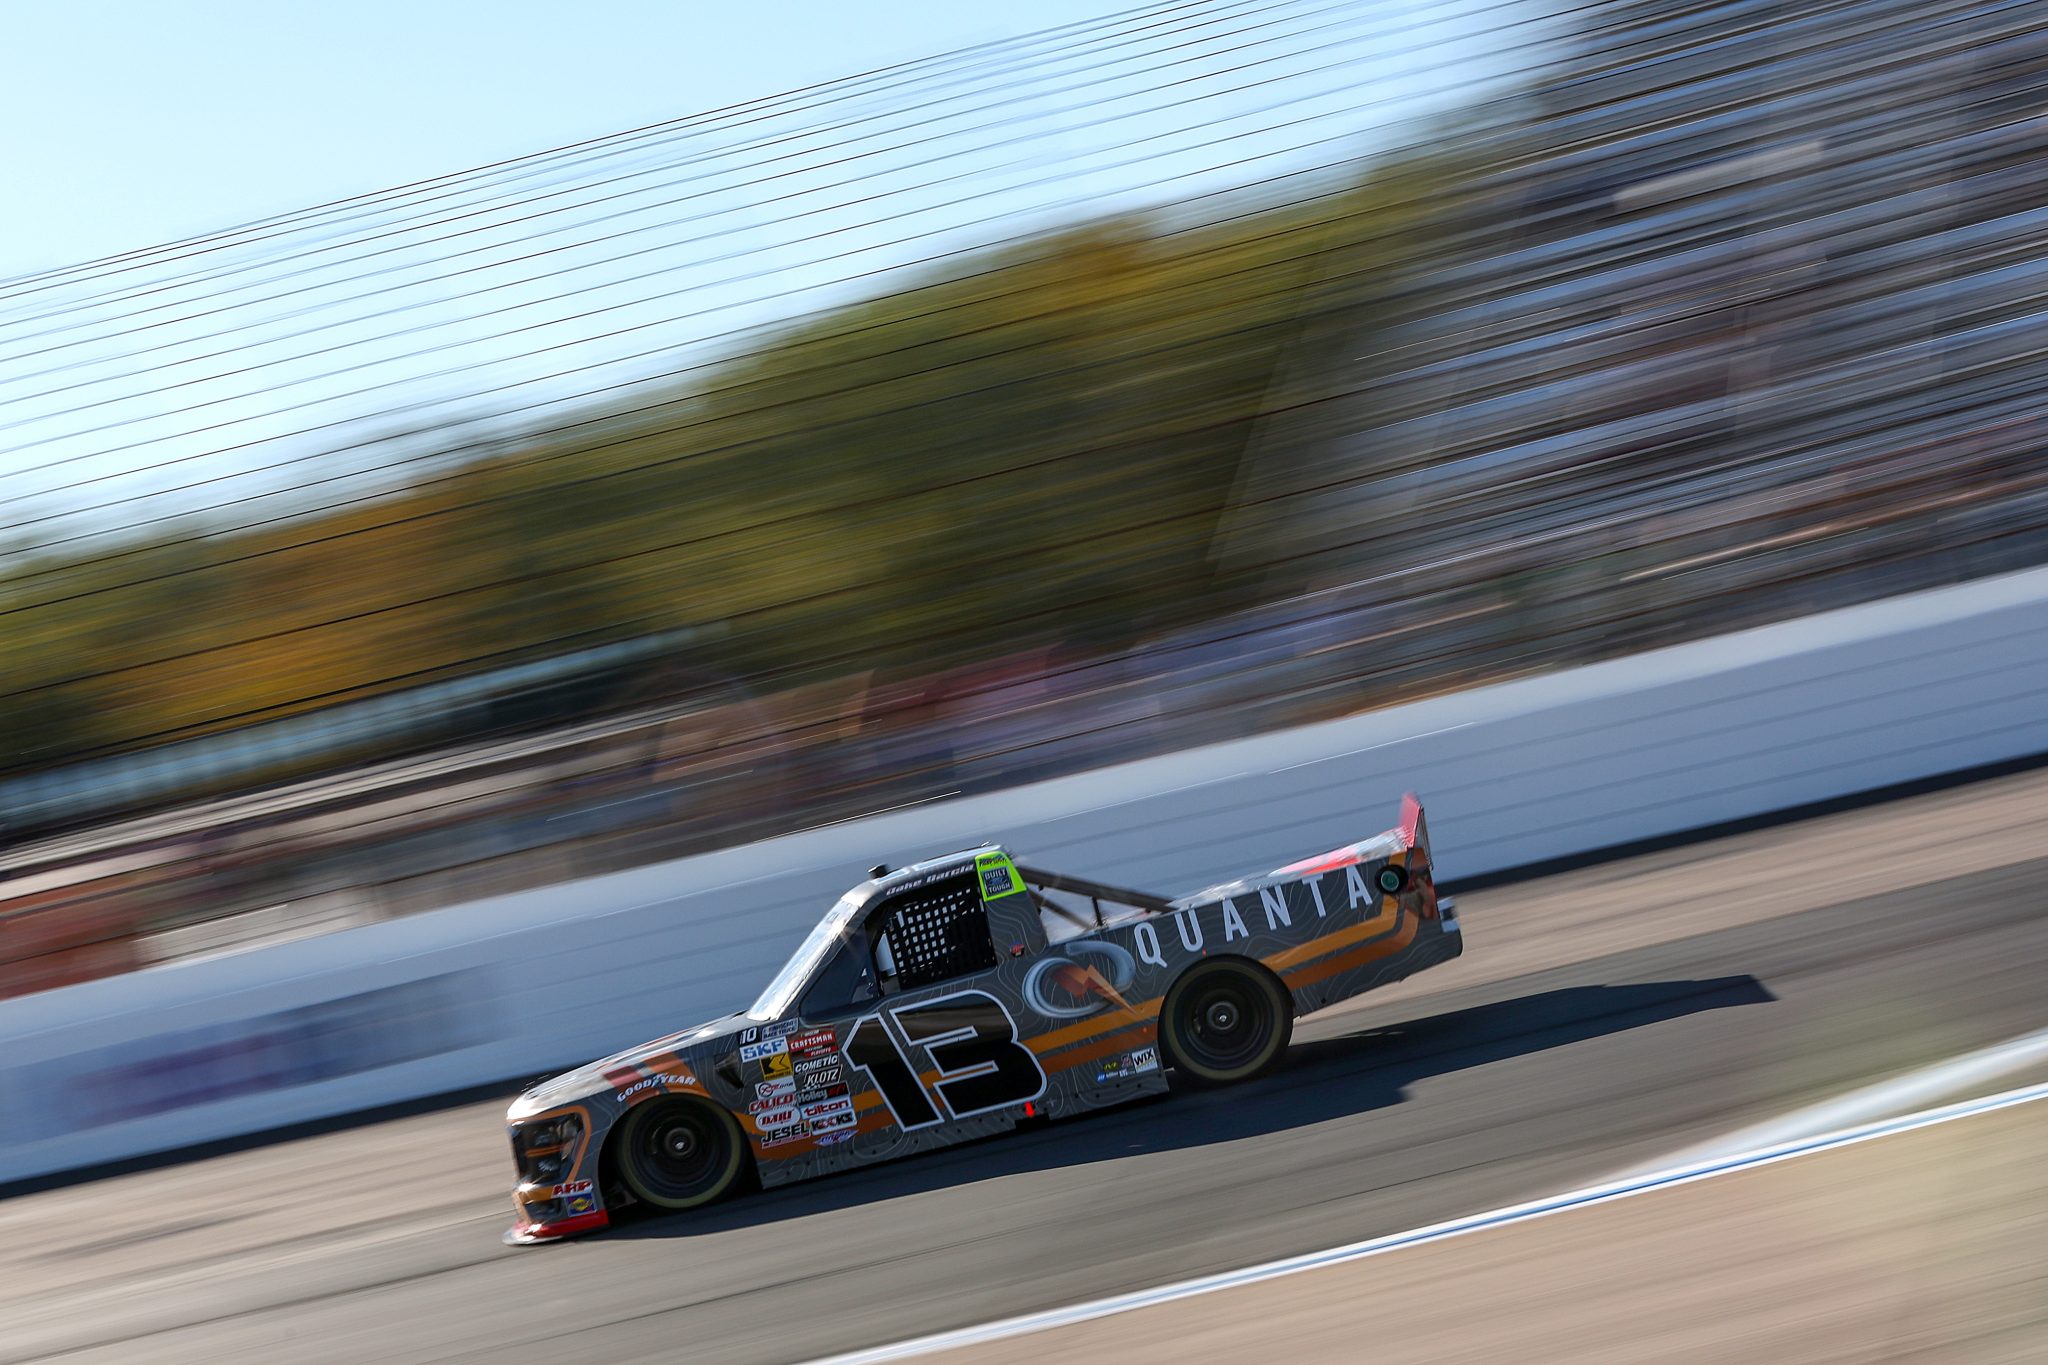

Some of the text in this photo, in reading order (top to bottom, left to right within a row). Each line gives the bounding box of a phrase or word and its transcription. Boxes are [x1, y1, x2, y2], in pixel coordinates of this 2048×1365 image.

[985, 868, 1006, 879] BUILT
[988, 883, 1011, 894] TOUGH
[1134, 865, 1373, 969] QUANTA
[740, 1027, 758, 1045] 10
[790, 1033, 833, 1050] CRAFTSMAN
[743, 1039, 785, 1060] SKF
[1134, 1049, 1154, 1066] WIX
[794, 1055, 838, 1073] COMETIC
[841, 988, 1048, 1132] 13
[806, 1068, 839, 1086] KLOTZ
[616, 1073, 697, 1103] GOODYEAR
[797, 1089, 828, 1104] Holley
[749, 1095, 794, 1113] CALICO
[804, 1100, 849, 1117] tilton
[811, 1112, 853, 1129] KOOKS
[762, 1123, 810, 1143] JESEL
[552, 1180, 593, 1196] ARP
